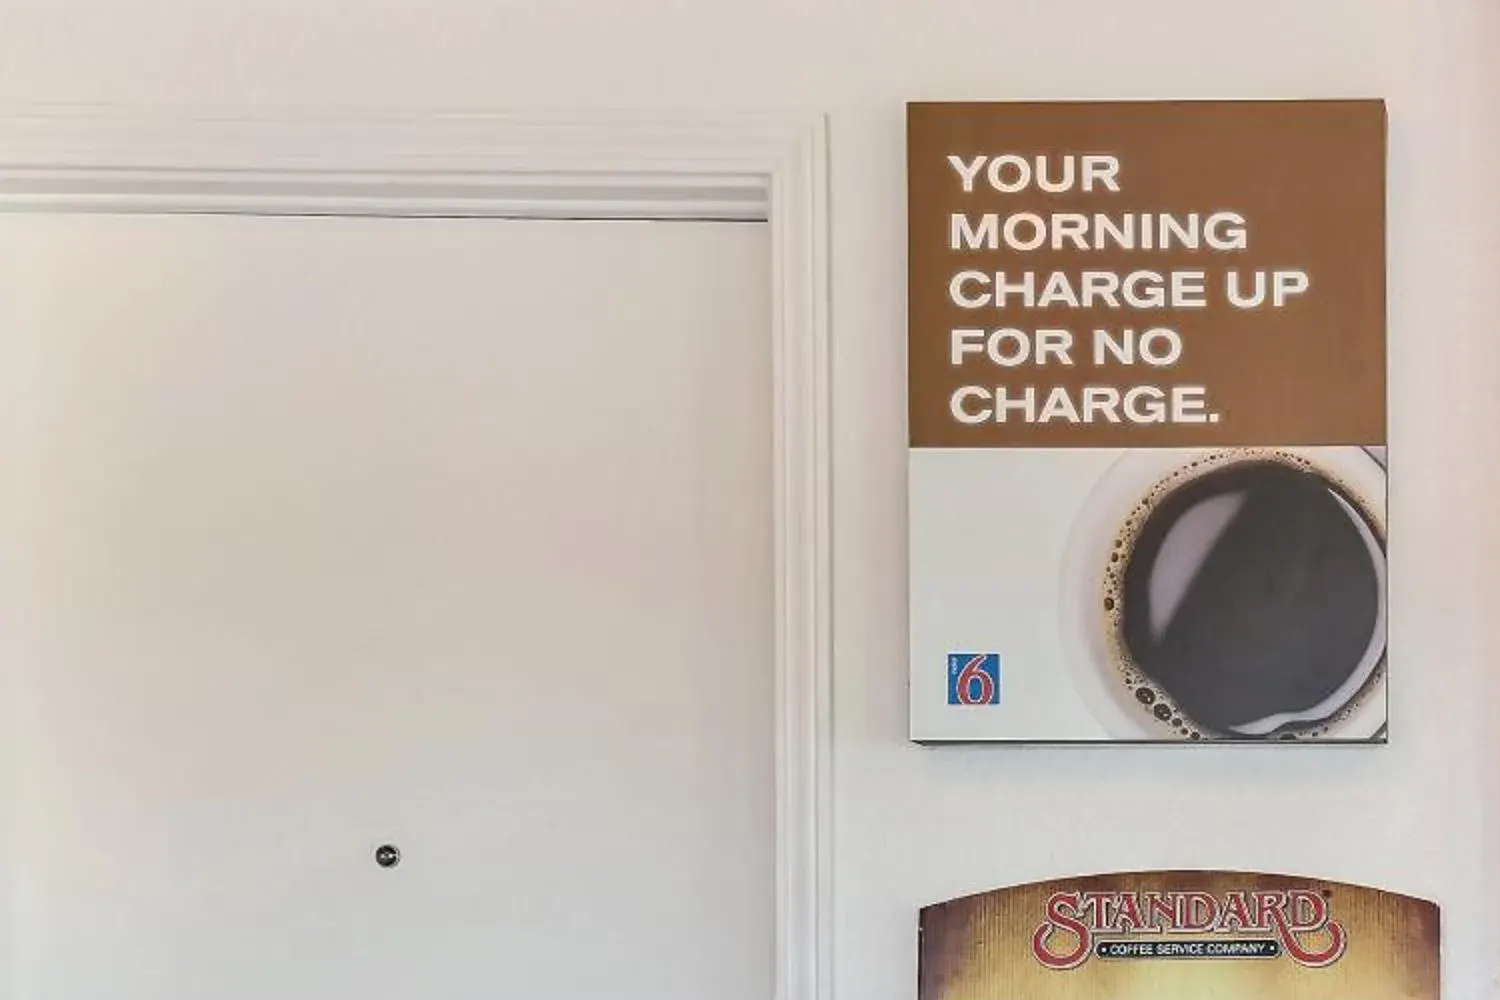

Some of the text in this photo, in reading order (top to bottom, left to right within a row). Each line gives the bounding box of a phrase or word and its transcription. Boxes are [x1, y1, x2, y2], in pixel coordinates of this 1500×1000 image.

[947, 155, 1120, 192] YOUR
[949, 213, 1247, 250] MORNING
[949, 271, 1309, 308] CHARGE UP
[951, 329, 1182, 365] FOR NO
[949, 387, 1219, 423] CHARGE.
[956, 654, 994, 705] 6
[1032, 891, 1346, 969] STANDARD
[1110, 943, 1265, 956] COFFEE SERVICE COMPANY
